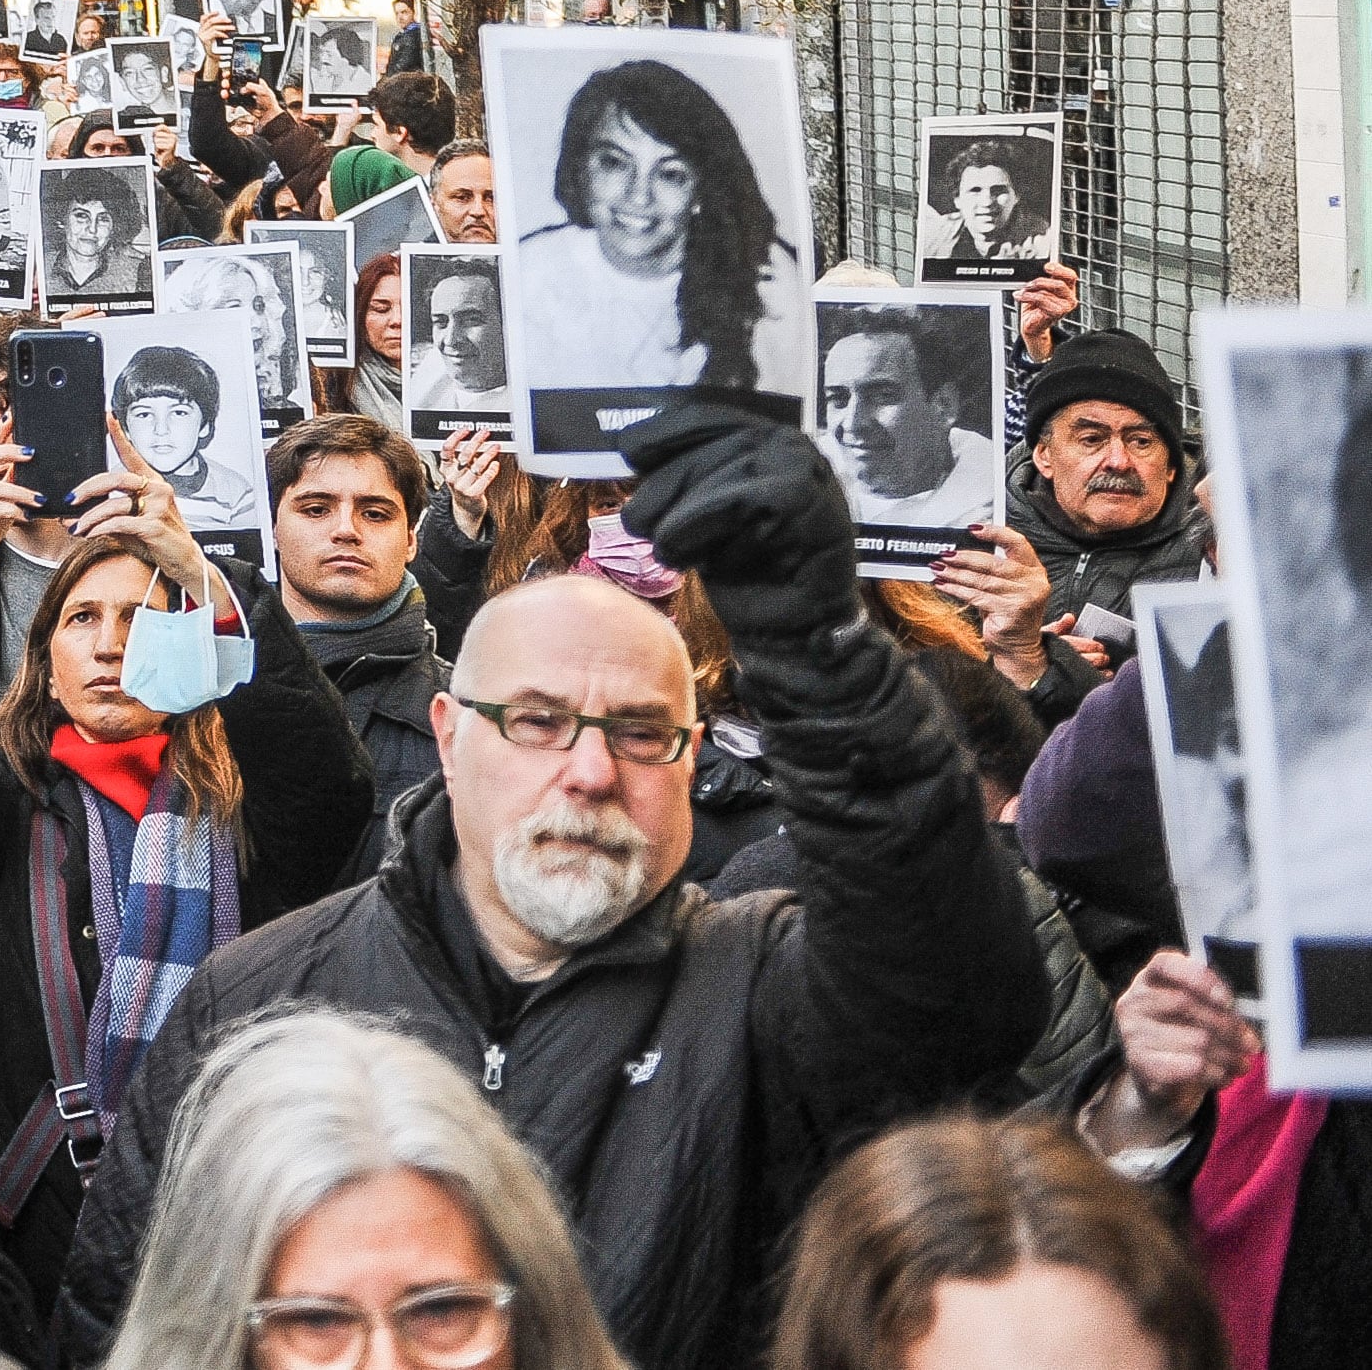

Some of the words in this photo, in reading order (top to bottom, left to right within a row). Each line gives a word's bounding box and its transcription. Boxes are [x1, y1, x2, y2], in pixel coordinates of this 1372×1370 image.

[475, 421, 512, 432] FERNAN
[855, 537, 885, 551] ERTO
[886, 541, 956, 555] FERNANDEZ
